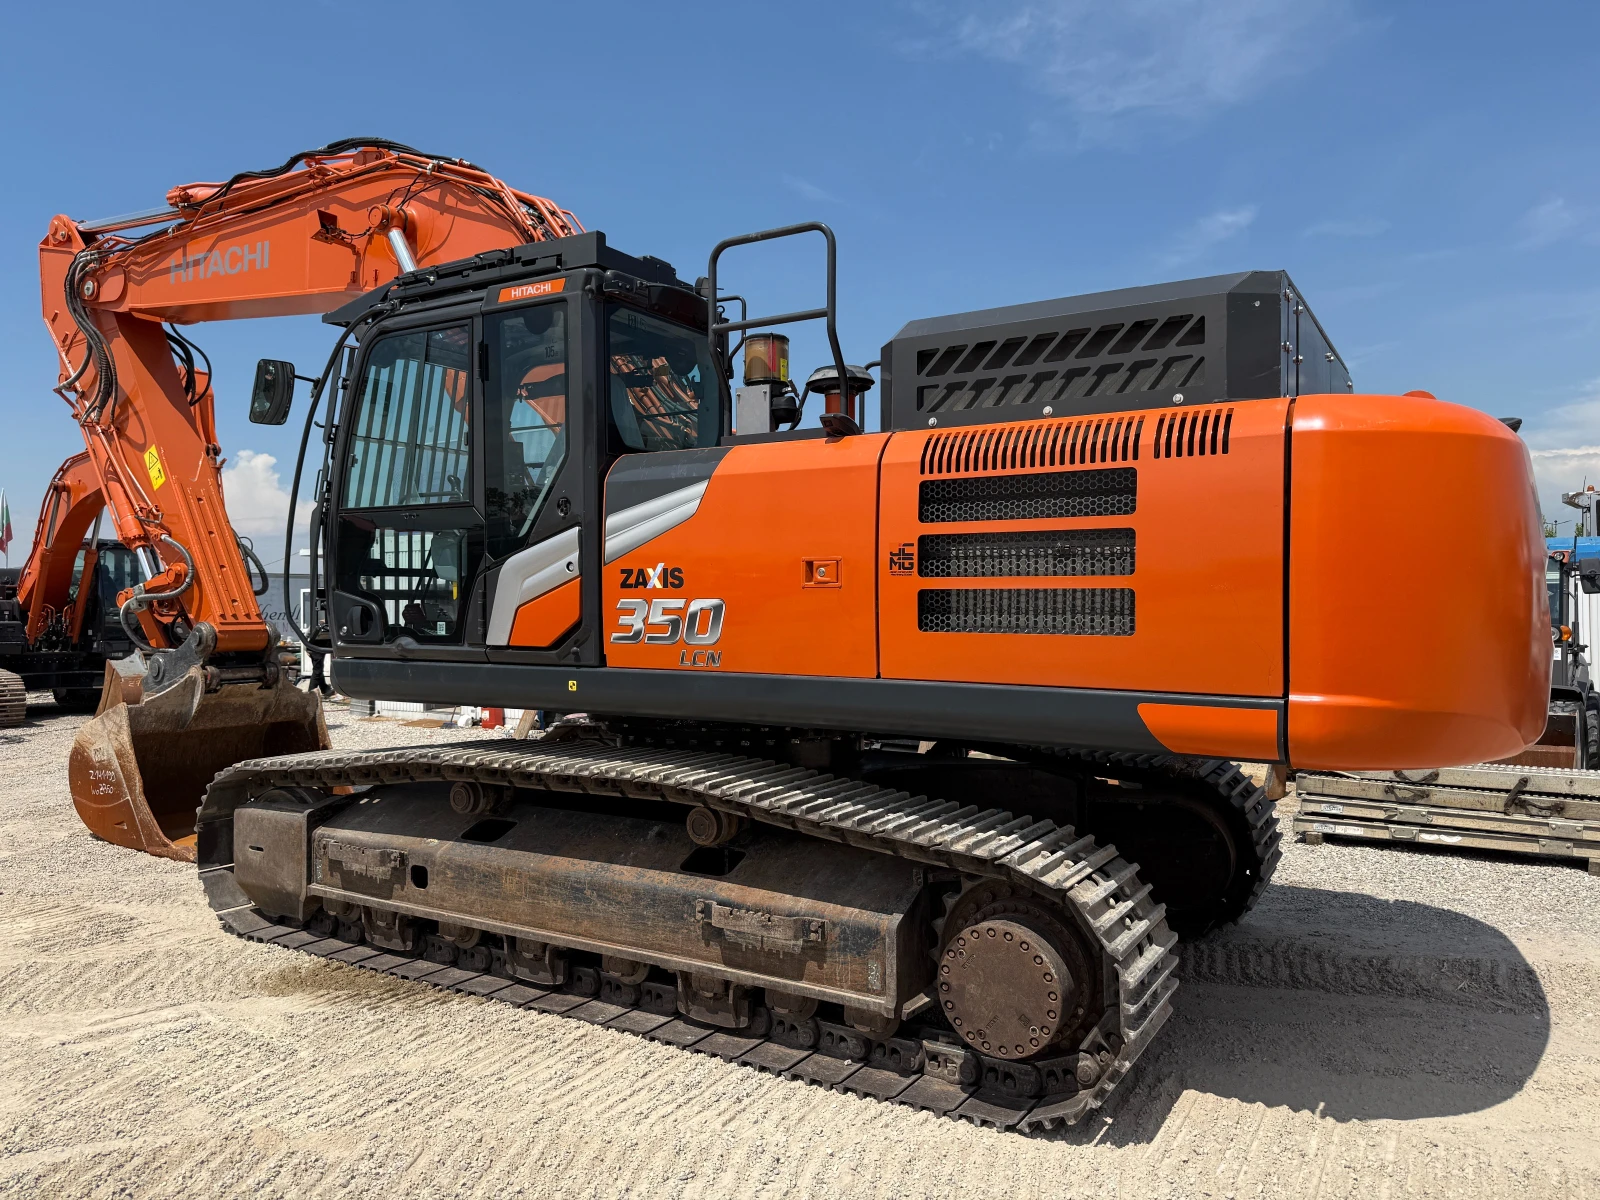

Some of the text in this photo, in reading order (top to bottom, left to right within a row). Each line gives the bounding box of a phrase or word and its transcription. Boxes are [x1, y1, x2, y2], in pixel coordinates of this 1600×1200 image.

[170, 240, 270, 285] HITACHI
[511, 283, 551, 298] HITACHI
[620, 562, 684, 589] ZAXIS
[610, 598, 726, 645] 350
[679, 649, 722, 667] LCN
